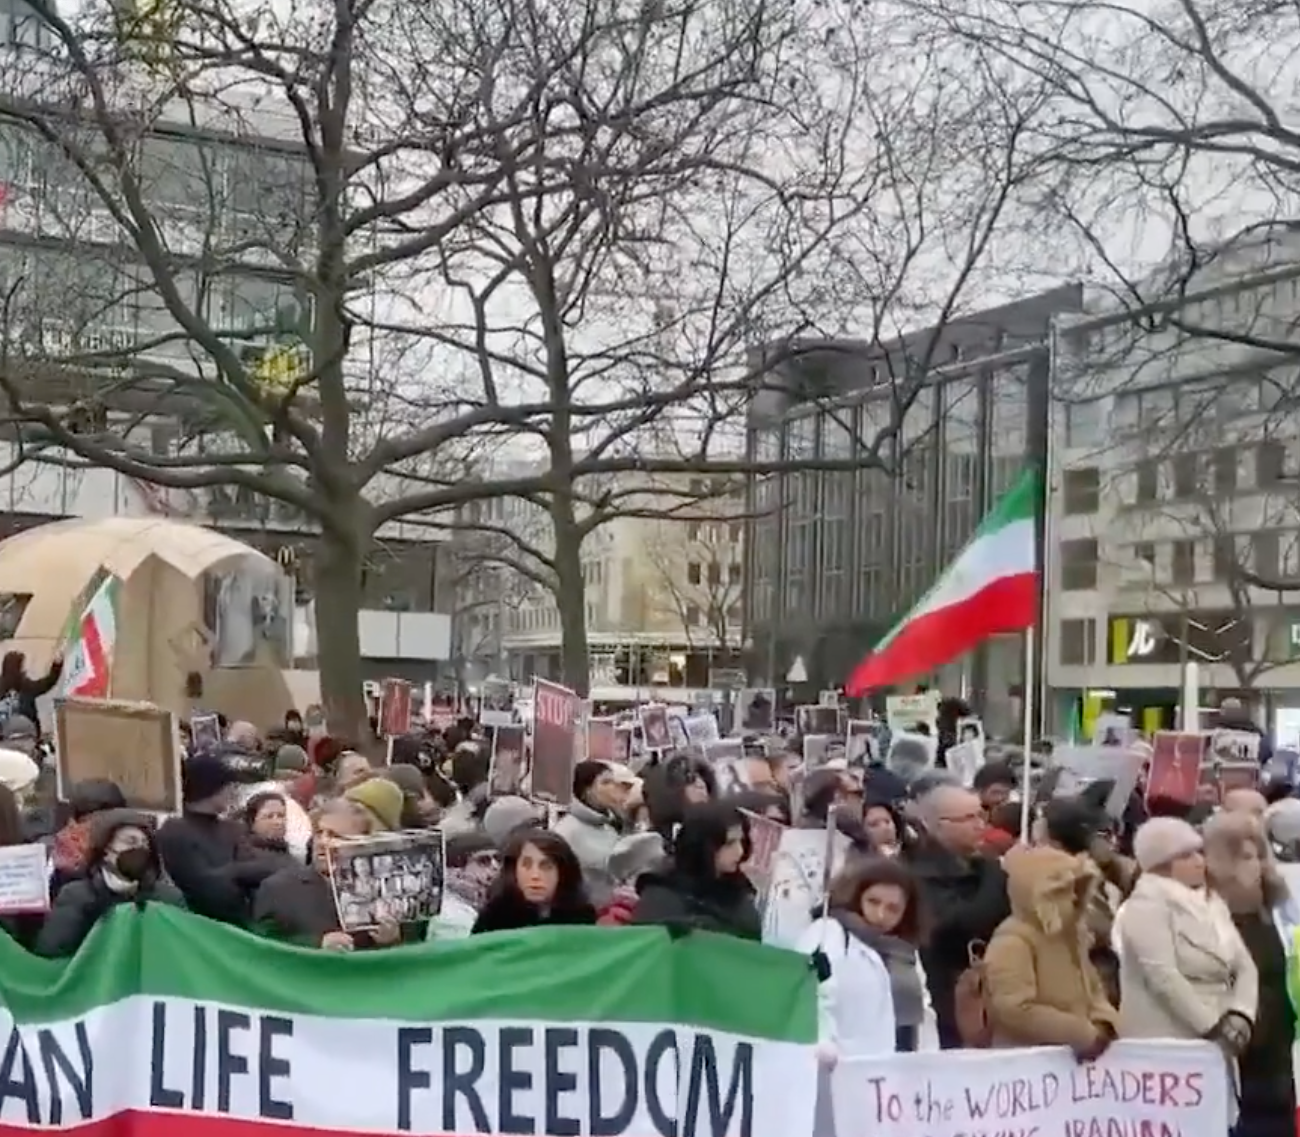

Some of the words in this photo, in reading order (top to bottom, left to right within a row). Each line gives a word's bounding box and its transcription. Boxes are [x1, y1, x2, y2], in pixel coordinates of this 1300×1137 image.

[537, 690, 574, 730] STOP
[150, 1001, 294, 1120] LIFE
[397, 1026, 754, 1137] FREEDOM
[868, 1077, 902, 1124] To
[914, 1080, 955, 1124] the
[965, 1073, 1060, 1121] WORLD
[1070, 1064, 1204, 1109] LEADERS
